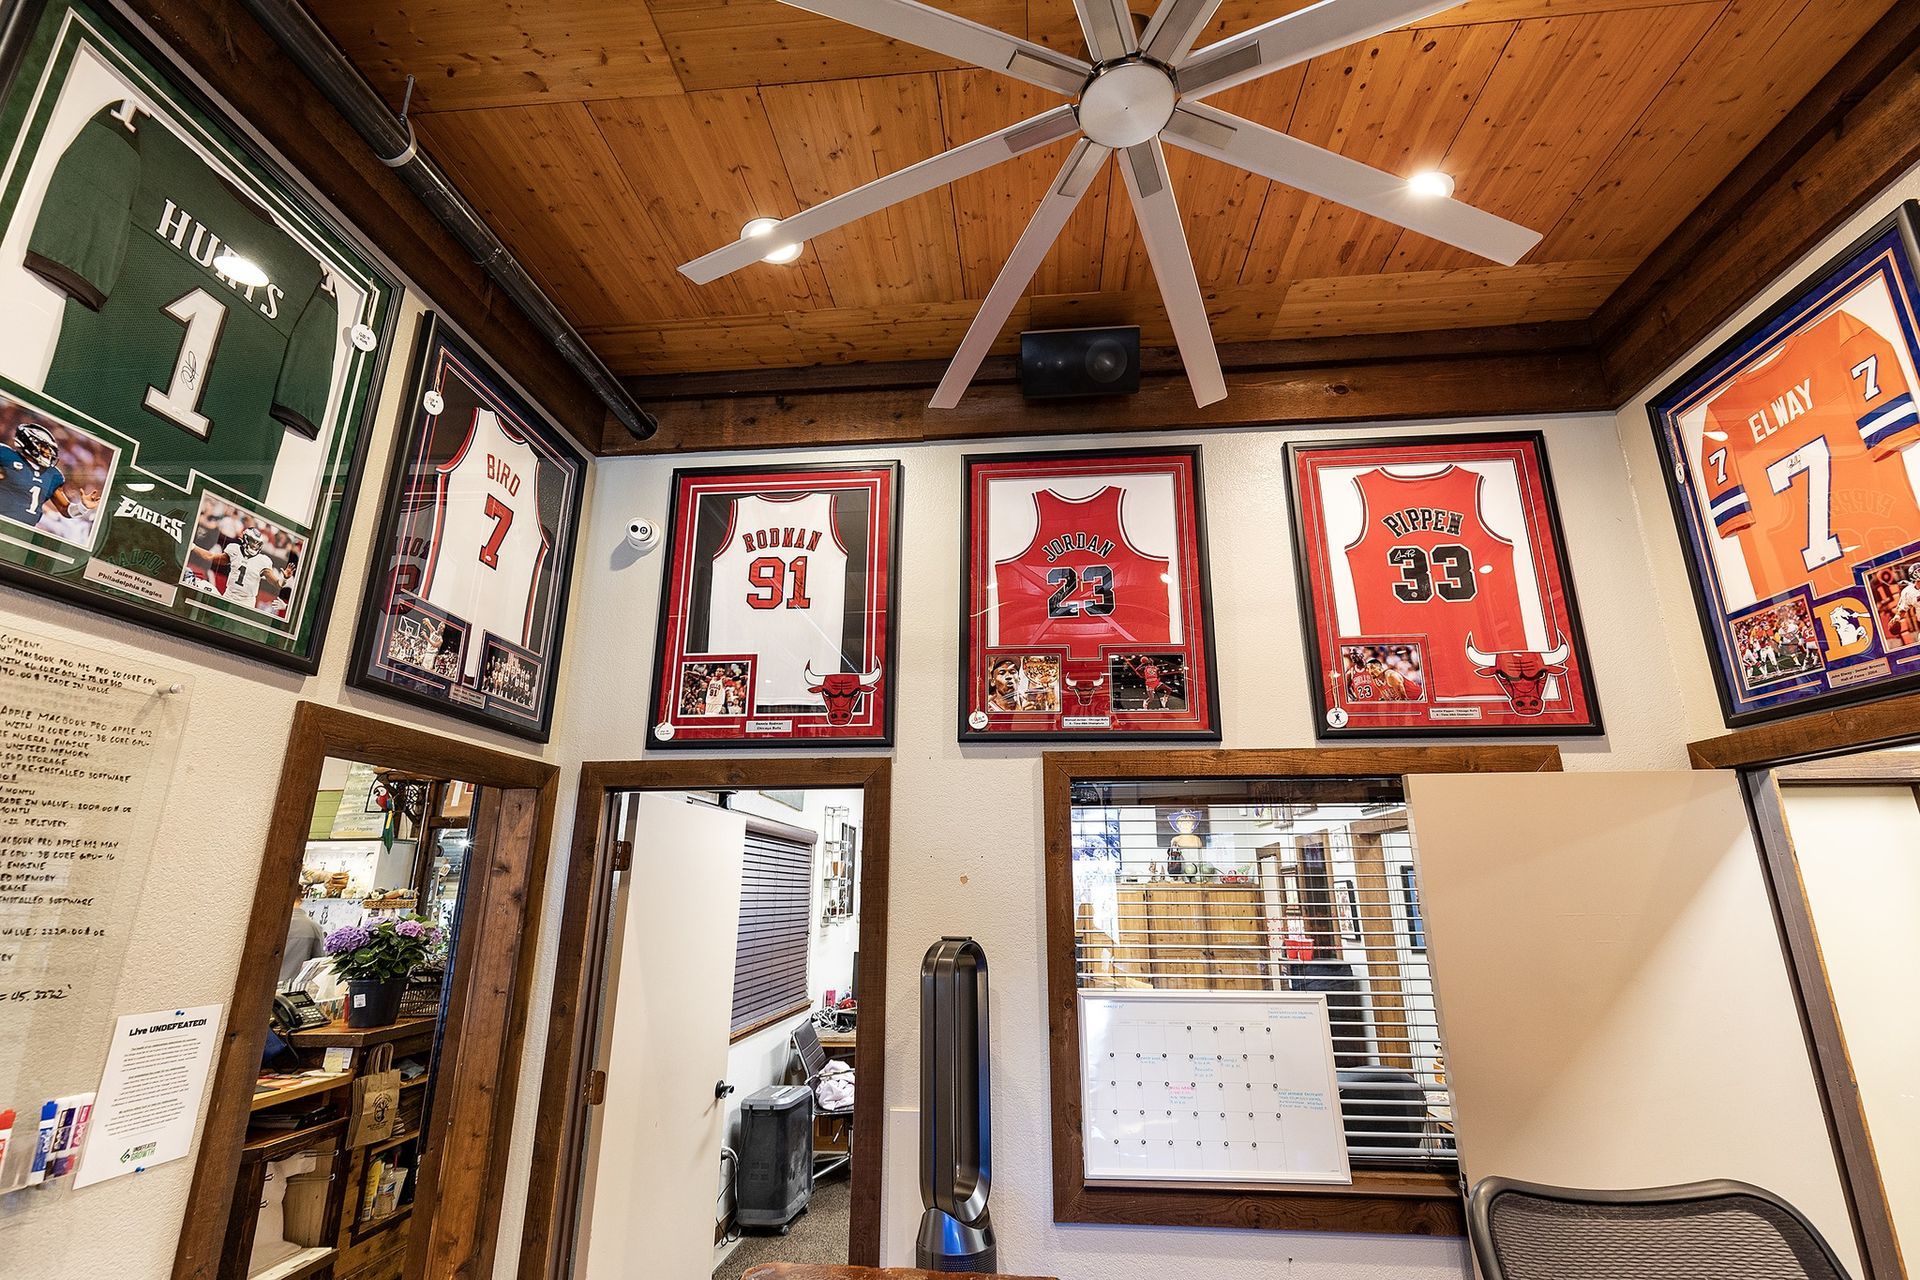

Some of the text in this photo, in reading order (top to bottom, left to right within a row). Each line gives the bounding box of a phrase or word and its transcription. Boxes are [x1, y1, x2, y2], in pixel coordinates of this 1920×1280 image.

[140, 285, 231, 444] 1
[1850, 353, 1882, 402] 7
[1747, 377, 1815, 444] ELWAY
[487, 453, 521, 498] BIRD
[1708, 447, 1728, 486] 7
[25, 485, 41, 515] 1
[1765, 433, 1845, 573] 7
[114, 495, 187, 544] EAGLES
[477, 492, 519, 571] 7
[1381, 507, 1465, 538] PIPPEN
[742, 527, 823, 553] RODMAN
[1041, 532, 1116, 563] JORDAN
[97, 571, 163, 599] Philadelphia Eagles
[114, 569, 153, 587] Jalen Hurts
[234, 564, 247, 587] 1
[746, 556, 811, 610] 91
[1386, 543, 1479, 604] 33
[1046, 564, 1116, 620] 23
[1356, 684, 1373, 699] 23
[0, 705, 33, 720] APPLE
[37, 712, 87, 728] MACBOOK
[90, 721, 108, 732] PRO
[111, 726, 136, 736] APPLE
[48, 727, 70, 737] CORE
[110, 736, 130, 745] CORE
[27, 755, 68, 766] STORAGE
[50, 748, 90, 759] MEMORY
[88, 772, 132, 784] SOFTWARE
[53, 851, 76, 860] CORE
[56, 838, 82, 849] APPLE
[6, 860, 47, 871] ENGINE
[48, 896, 95, 907] SOFTWARE
[129, 1017, 208, 1037] Live UNDEFEATED!
